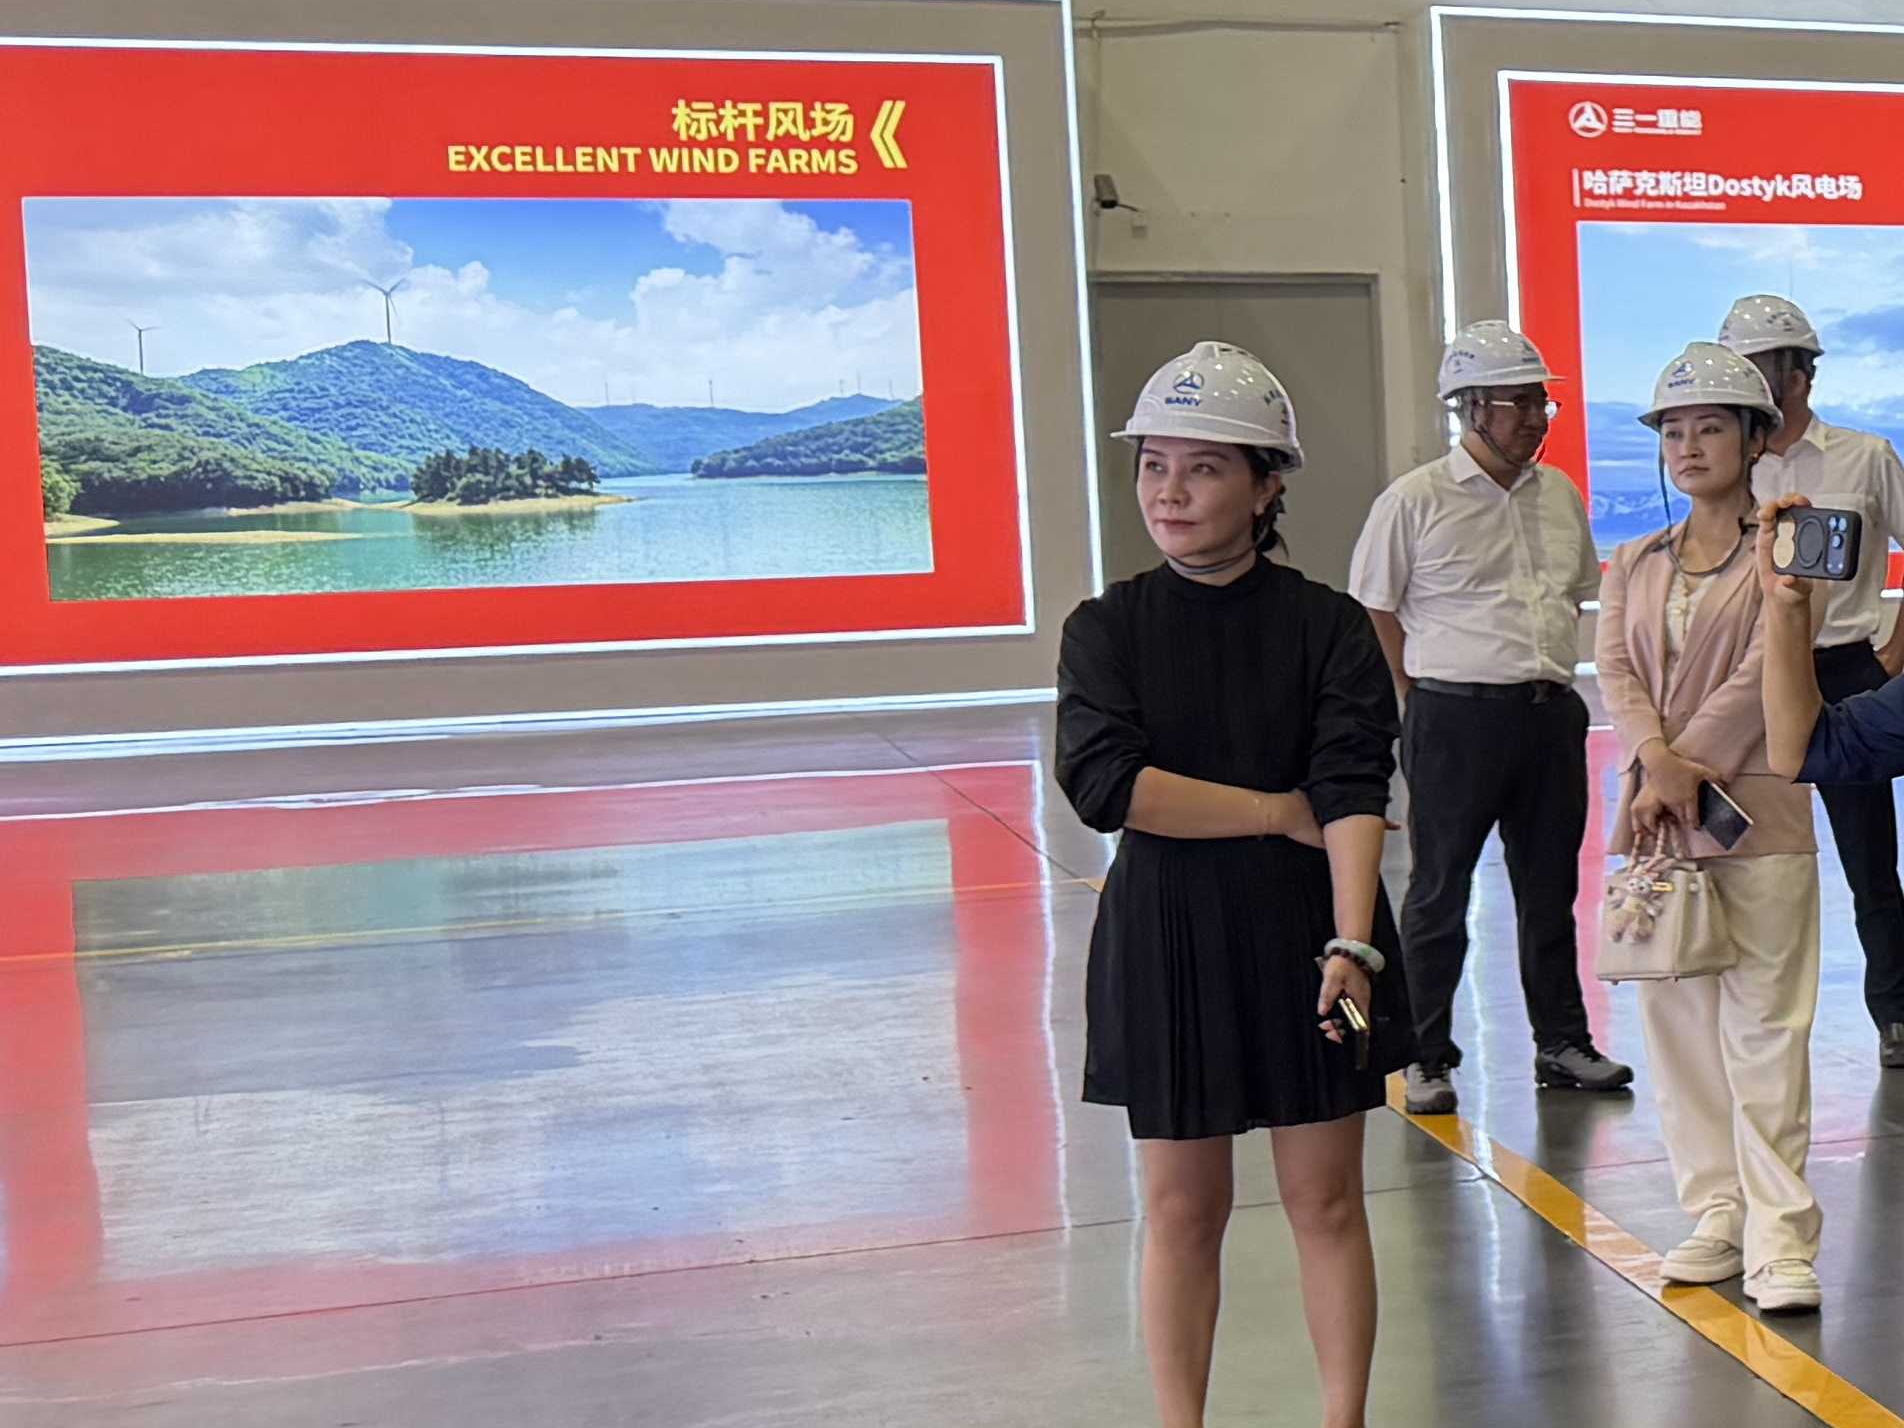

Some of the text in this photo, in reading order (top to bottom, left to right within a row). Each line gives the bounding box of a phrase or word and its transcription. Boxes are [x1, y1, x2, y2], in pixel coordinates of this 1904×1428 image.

[671, 98, 855, 142] 标杆风场
[447, 145, 859, 175] EXCELLENT WIND FARMS
